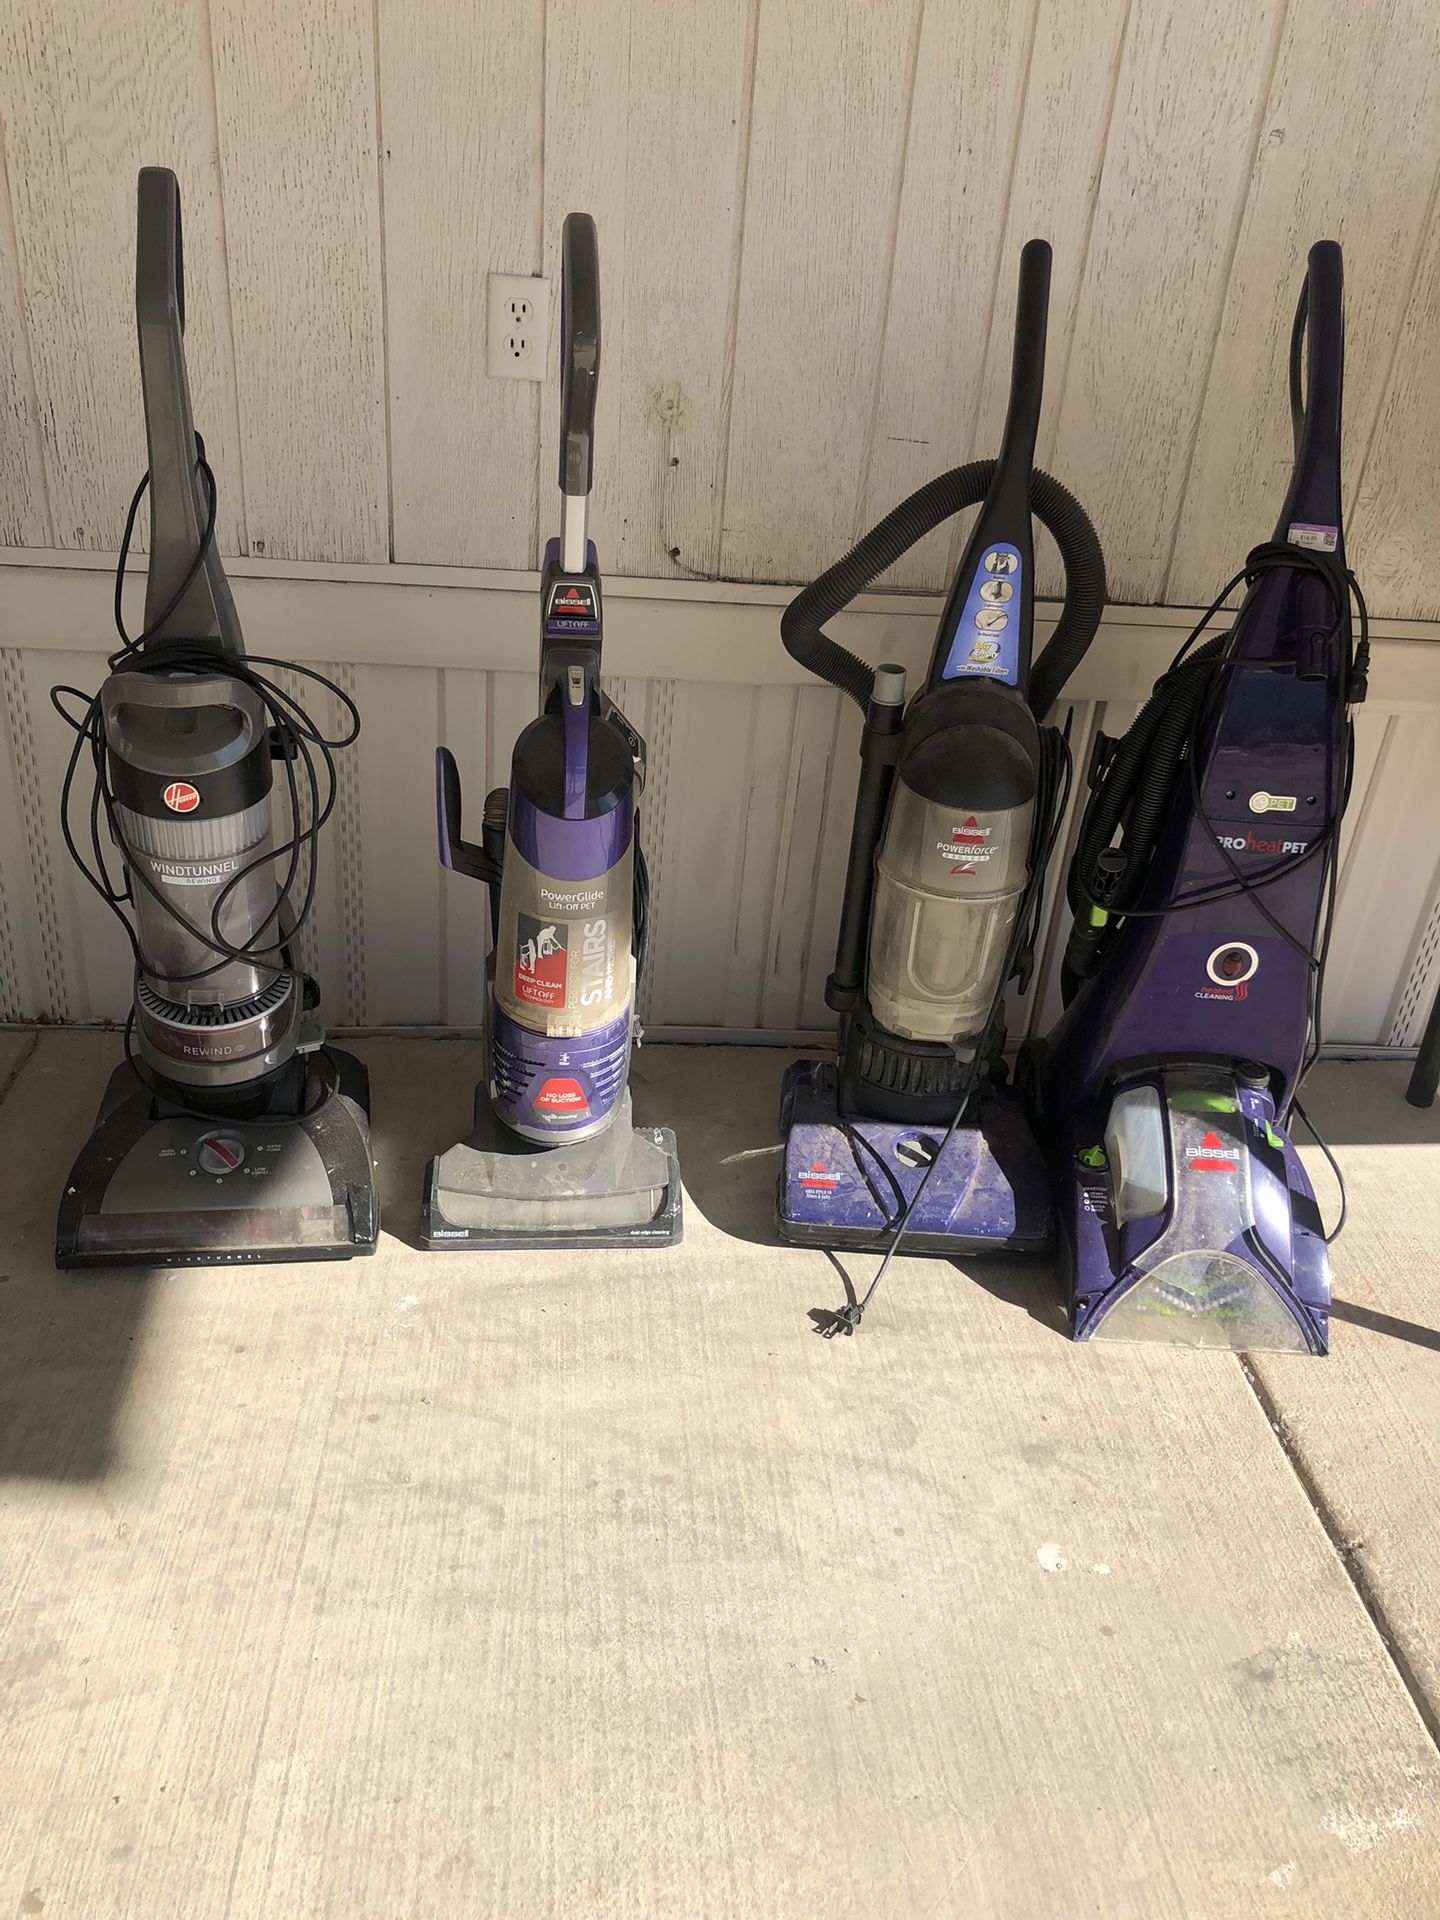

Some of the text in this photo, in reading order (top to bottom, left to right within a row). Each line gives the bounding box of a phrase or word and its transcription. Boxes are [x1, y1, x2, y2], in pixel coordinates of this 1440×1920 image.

[974, 649, 999, 660] Empty
[1269, 799, 1293, 809] PET
[936, 843, 996, 855] POWERforce
[150, 861, 239, 876] WINDTUNNEL
[186, 876, 218, 885] REWIND
[541, 888, 604, 902] PowerGlide
[548, 901, 597, 911] Lift-Off PET
[580, 919, 607, 1006] STAIRS
[518, 973, 562, 989] DEEP CLEAN
[604, 975, 614, 1000] AND
[1201, 986, 1234, 995] heated
[1194, 992, 1234, 1001] CLEANING
[183, 1045, 233, 1056] REWIND
[1186, 1145, 1240, 1160] Bissell
